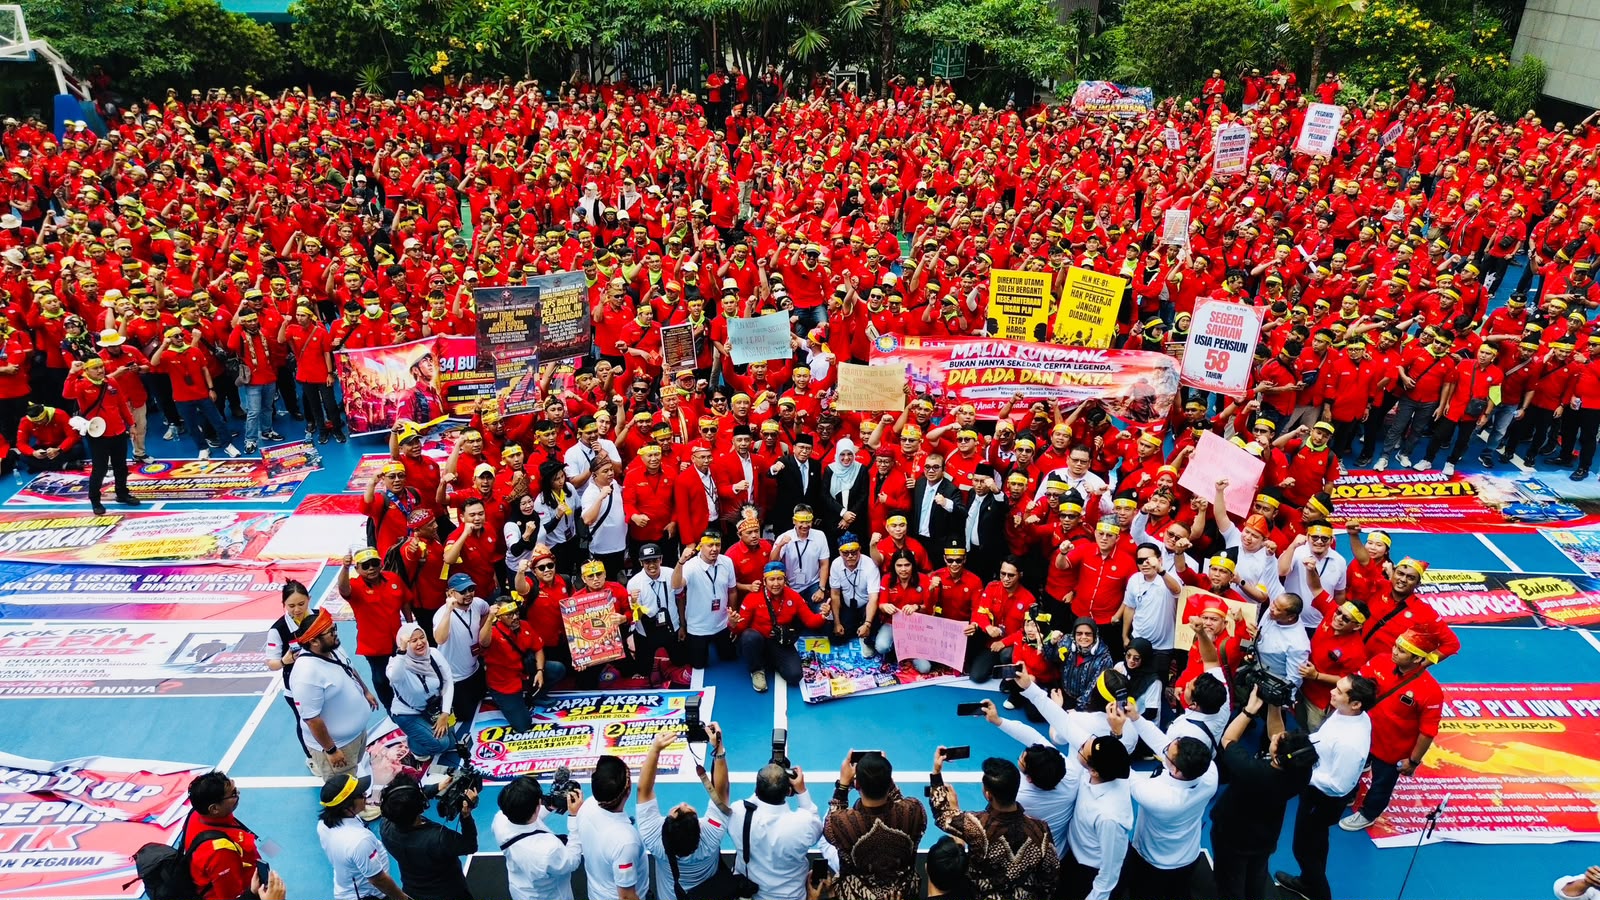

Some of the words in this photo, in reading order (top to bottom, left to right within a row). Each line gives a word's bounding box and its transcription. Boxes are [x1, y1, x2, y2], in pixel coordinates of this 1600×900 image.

[997, 276, 1023, 286] DIREKTUR
[1081, 275, 1093, 283] HLN
[997, 284, 1015, 293] BOLEH
[1016, 287, 1043, 295] BERGANTI
[543, 301, 557, 310] APS
[557, 296, 579, 307] BUKAN
[1071, 289, 1084, 300] HAK
[1085, 293, 1113, 307] PEKERJA
[1076, 301, 1102, 315] JANGAN
[542, 310, 583, 325] PERJUANGAN
[1008, 316, 1027, 325] TETAP
[1069, 310, 1104, 326] DIABAIKAN!
[1209, 311, 1244, 327] SEGERA
[1006, 326, 1027, 334] HARGA
[1206, 323, 1243, 341] SAHKAN
[1194, 334, 1214, 348] USIA
[1213, 337, 1249, 354] PENSIUN
[950, 340, 1011, 360] MALIN
[1015, 343, 1110, 363] KUNDANG
[440, 356, 455, 372] 34
[949, 359, 977, 369] BUKAN
[979, 359, 1007, 368] HANYA
[1007, 358, 1043, 369] SEKEDAR
[1044, 361, 1073, 370] CERITA
[1074, 363, 1115, 371] LEGENDA,
[1204, 348, 1231, 372] 58
[947, 370, 978, 386] DIA
[980, 367, 1016, 385] ADA
[1020, 369, 1056, 385] DAN
[1060, 371, 1114, 386] NYATA
[1205, 370, 1223, 380] TAHUN
[211, 466, 257, 474] PLN
[1383, 473, 1450, 484] SELURUH
[27, 574, 75, 583] JAGA
[75, 574, 142, 583] LISTRIK
[142, 574, 165, 583] DI
[165, 574, 254, 583] INDONESIA
[1425, 572, 1477, 582] Indonesia,
[0, 582, 46, 591] KALO
[46, 582, 73, 591] GA
[138, 582, 204, 592] DIMAKI
[203, 582, 250, 592] ATAU
[1518, 581, 1568, 597] Bukan,
[565, 606, 577, 614] PLN
[5, 629, 63, 637] KOK
[69, 627, 128, 636] BISA
[602, 695, 661, 708] AKBAR
[569, 706, 597, 717] SP
[598, 704, 639, 714] PLN
[1452, 699, 1482, 717] SP
[1482, 699, 1530, 718] PLN
[1523, 699, 1573, 718] UIW
[626, 718, 682, 729] TUNTASKAN
[1463, 722, 1482, 730] SP
[1484, 722, 1510, 730] PLN
[1510, 722, 1557, 730] PAPUA
[503, 728, 566, 743] DOMINASI
[620, 735, 656, 743] PERSON
[508, 738, 551, 749] TEGAKKAN
[551, 736, 567, 744] UUD
[517, 743, 545, 752] PASAL
[497, 762, 534, 777] KAMI
[535, 759, 567, 772] YAKIN
[1416, 777, 1460, 785] Mengawal
[91, 780, 165, 803] ULP
[1471, 815, 1493, 823] PLN
[1490, 815, 1513, 823] UIW
[1511, 815, 1548, 823] PAPUA
[21, 856, 105, 869] PEGAWAI
